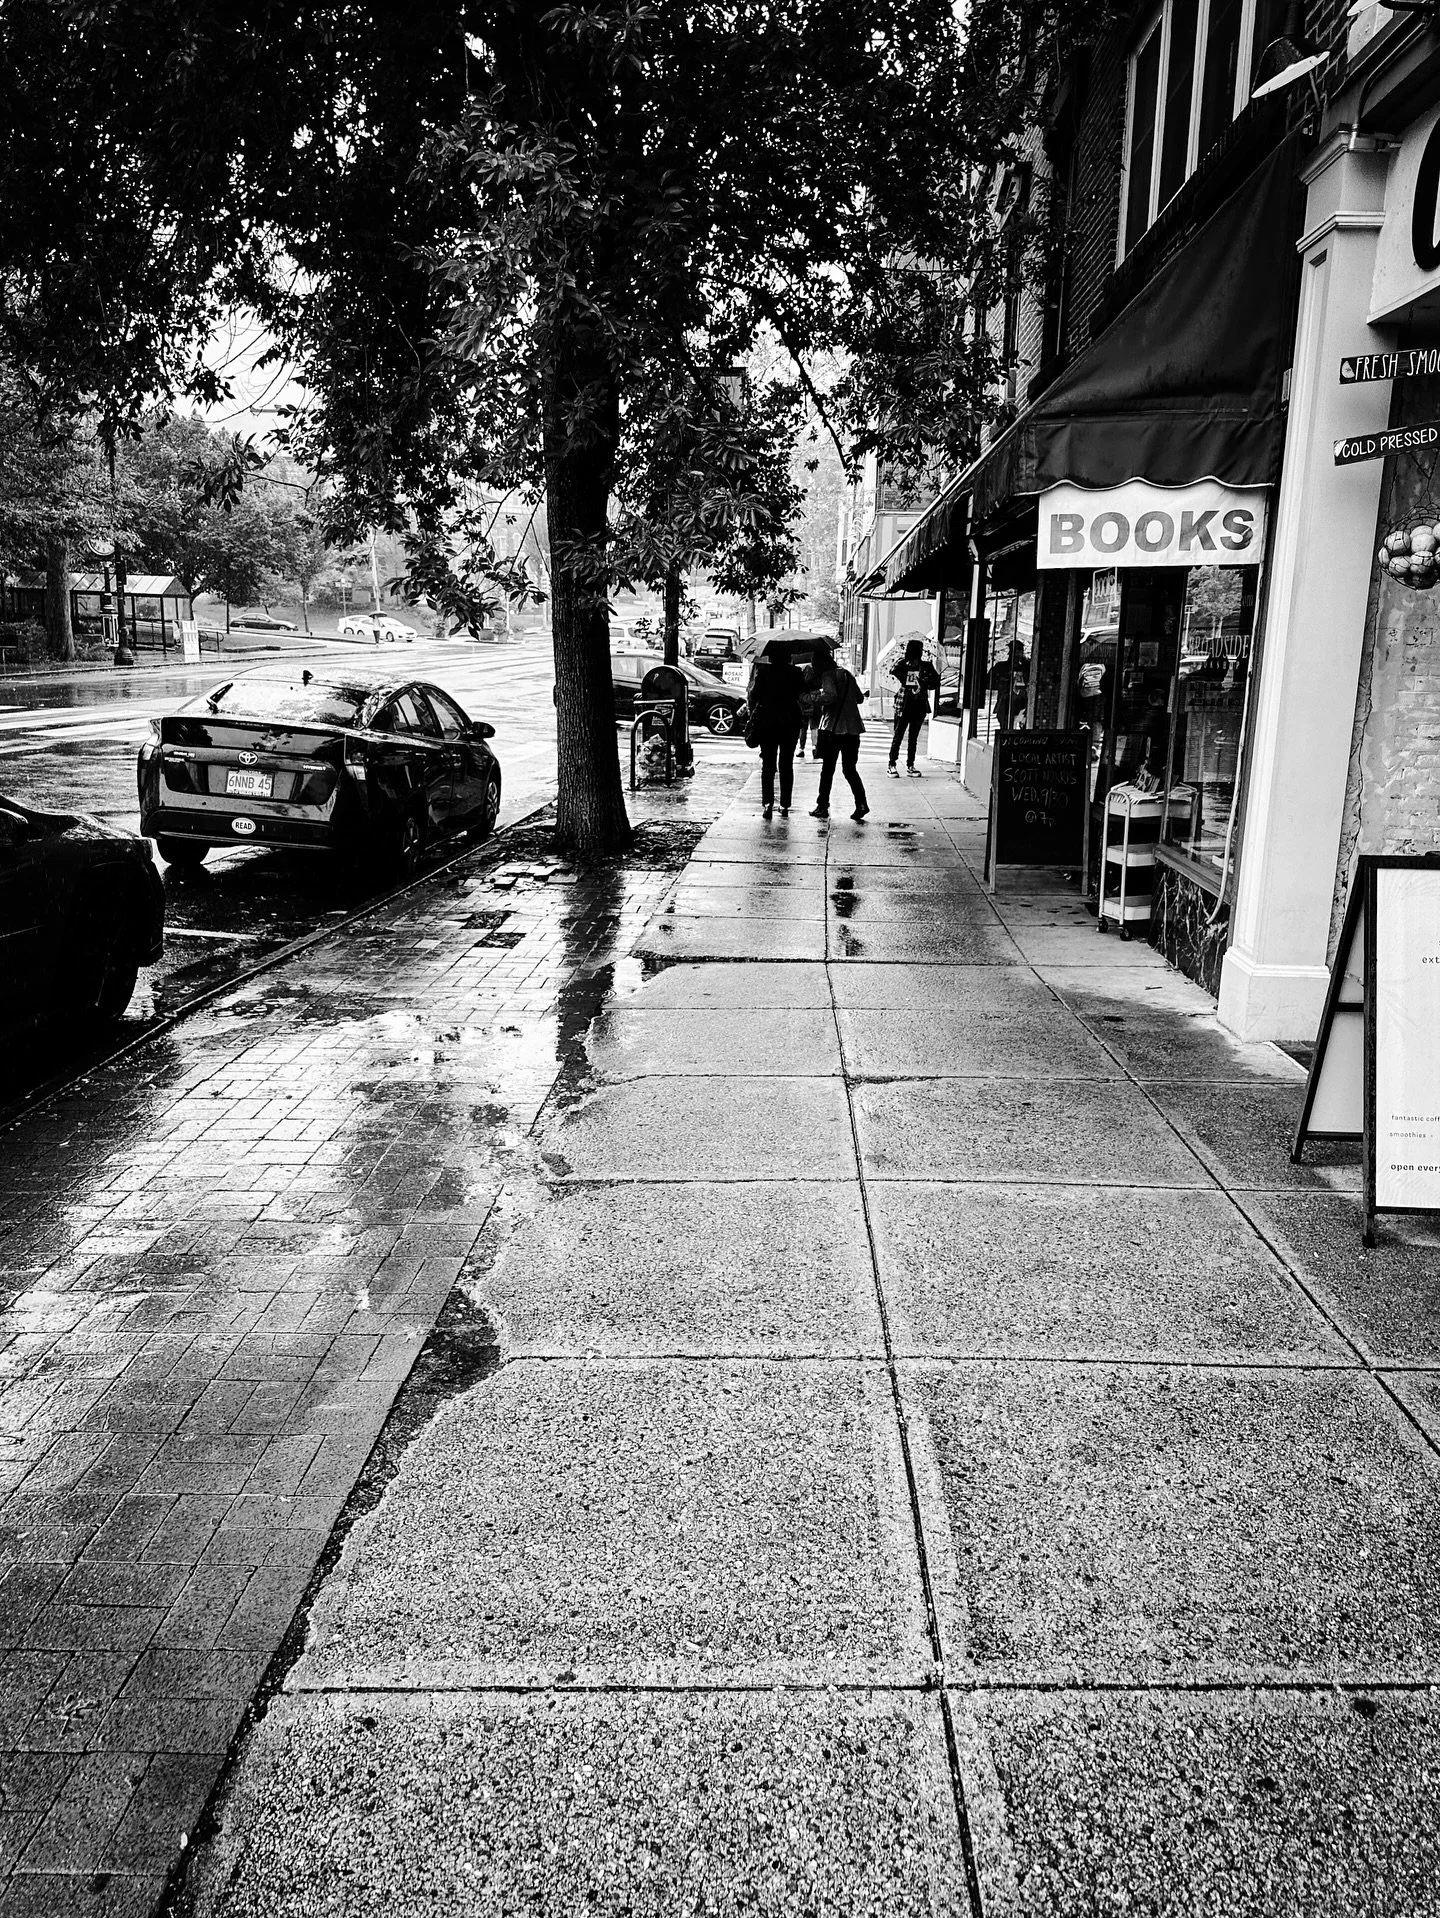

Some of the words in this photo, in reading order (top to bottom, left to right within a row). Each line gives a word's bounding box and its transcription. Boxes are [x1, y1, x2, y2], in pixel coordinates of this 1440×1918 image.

[1355, 353, 1399, 380] FRESH
[1342, 440, 1376, 458] COLD
[1380, 428, 1438, 451] PRESSED
[1049, 509, 1254, 554] BOOKS
[1011, 753, 1041, 764] LOCAL
[1045, 753, 1077, 767] ARTIST
[1004, 767, 1041, 783] SCOTT
[228, 776, 255, 789] 6NNB
[258, 778, 272, 791] 45
[235, 821, 253, 830] READ
[1391, 1114, 1424, 1122] fantastic
[1391, 1164, 1414, 1172] open
